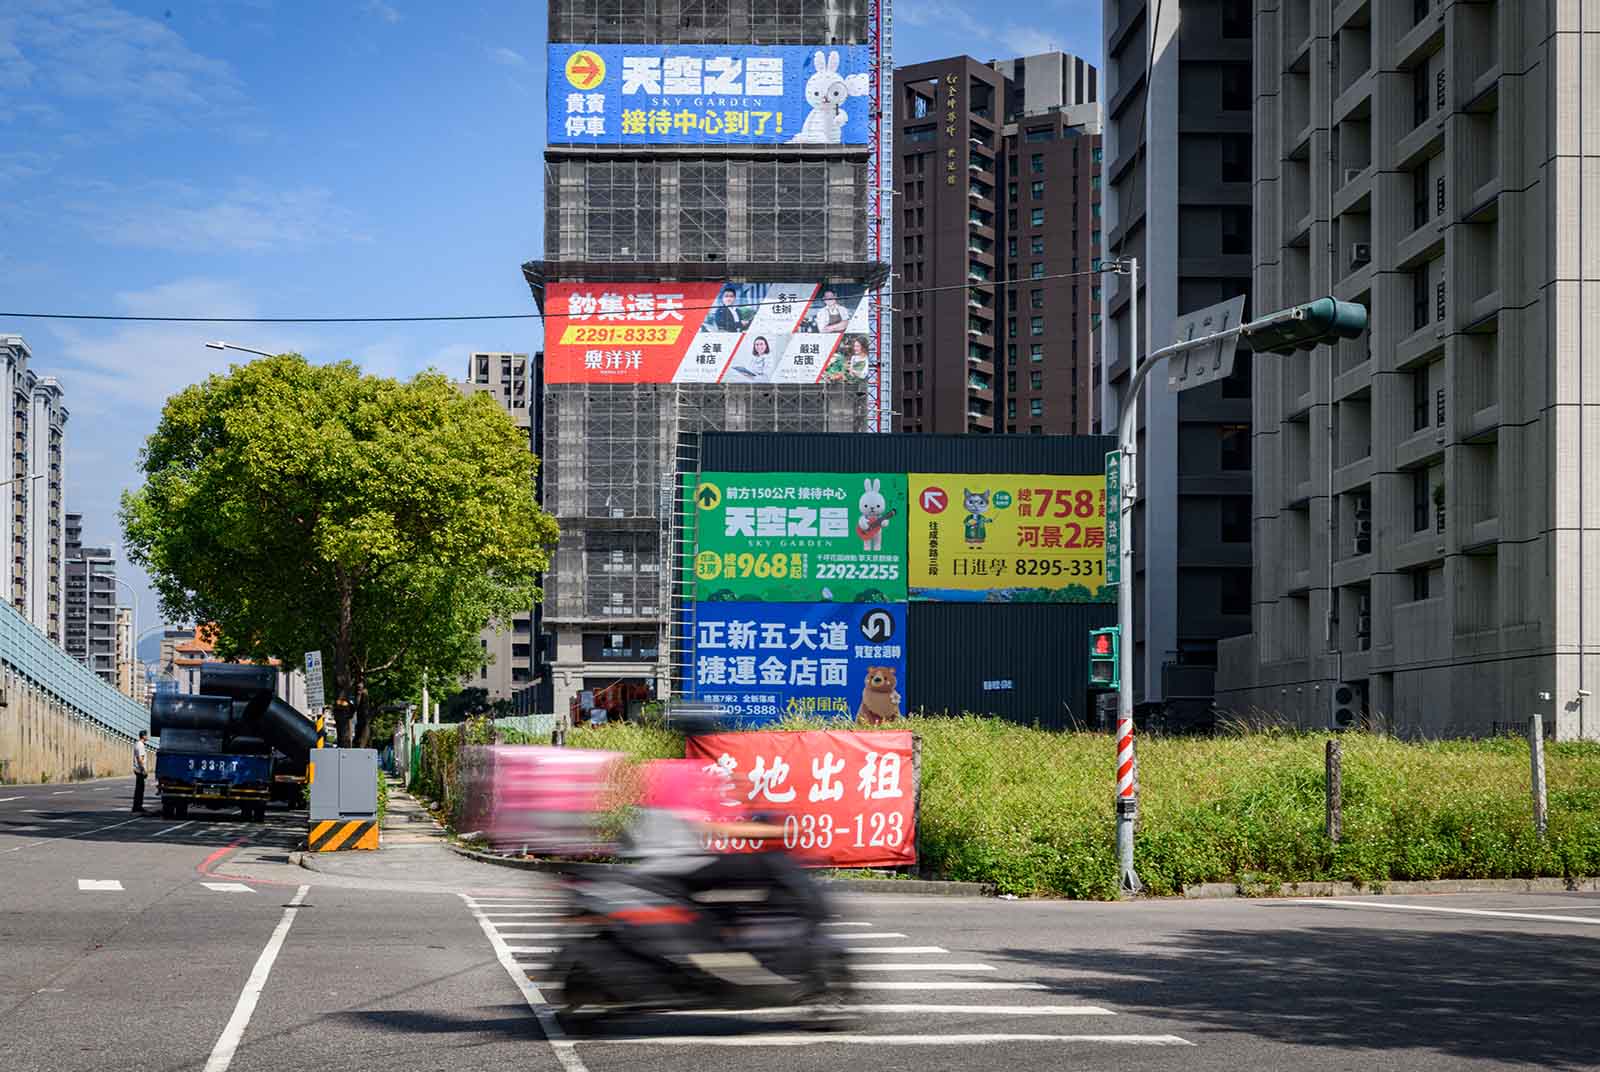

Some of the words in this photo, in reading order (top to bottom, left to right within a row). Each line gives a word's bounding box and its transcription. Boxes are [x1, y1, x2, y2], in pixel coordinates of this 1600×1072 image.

[566, 94, 605, 113] 貴賓
[652, 98, 682, 106] SKY
[694, 98, 762, 106] GARDEN
[566, 117, 605, 137] 停車
[621, 110, 783, 135] 接待中心到了!
[575, 328, 668, 341] 2291-8333
[793, 355, 814, 366] 店面
[726, 487, 795, 500] 前方150公尺
[1034, 489, 1093, 518] 758
[1017, 523, 1105, 549] 河景2房
[737, 553, 788, 579] 968
[816, 564, 899, 579] 2292-2255
[697, 620, 848, 650] 正新五大道
[697, 656, 848, 686] 捷運金店面
[783, 812, 903, 849] 033-123
